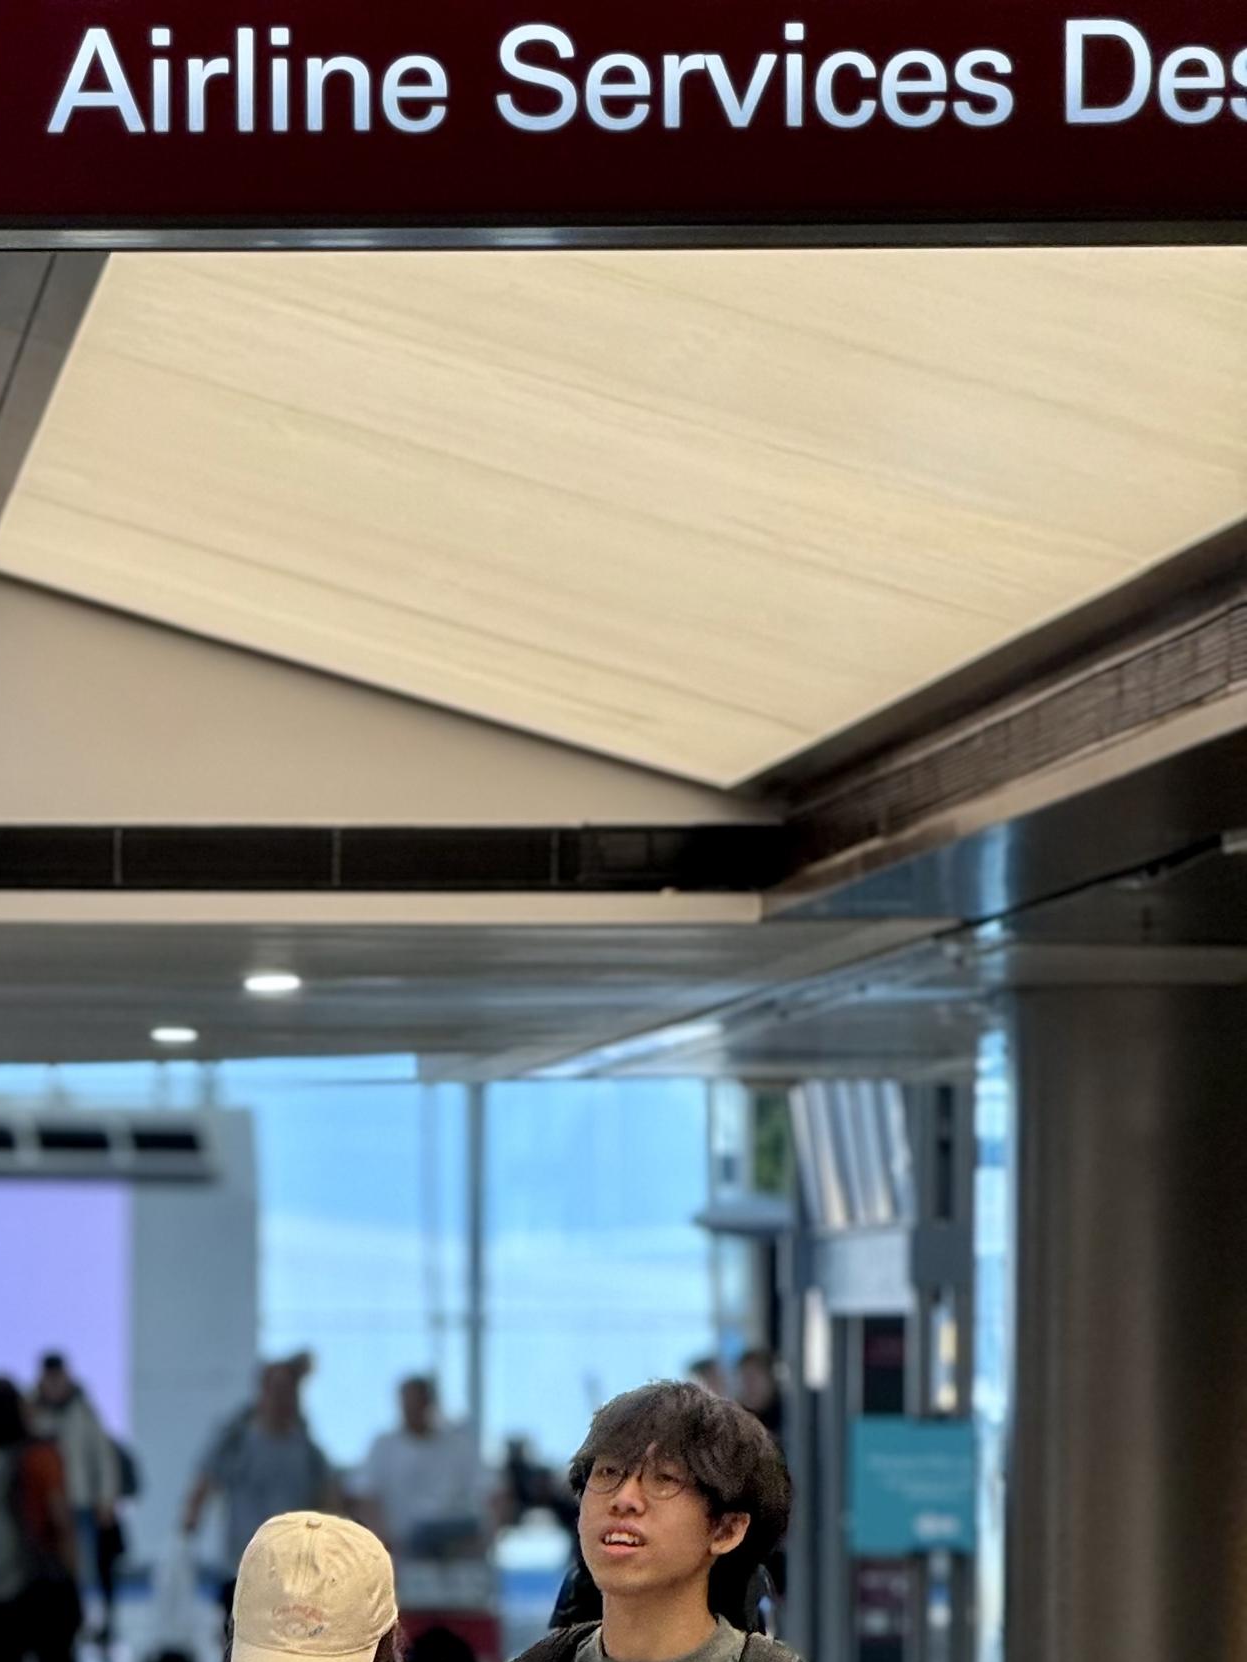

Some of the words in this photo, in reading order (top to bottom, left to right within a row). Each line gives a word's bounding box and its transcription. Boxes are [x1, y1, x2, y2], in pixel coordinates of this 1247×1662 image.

[47, 26, 448, 134] Airline
[496, 22, 1014, 132] Services
[1065, 18, 1247, 125] De
